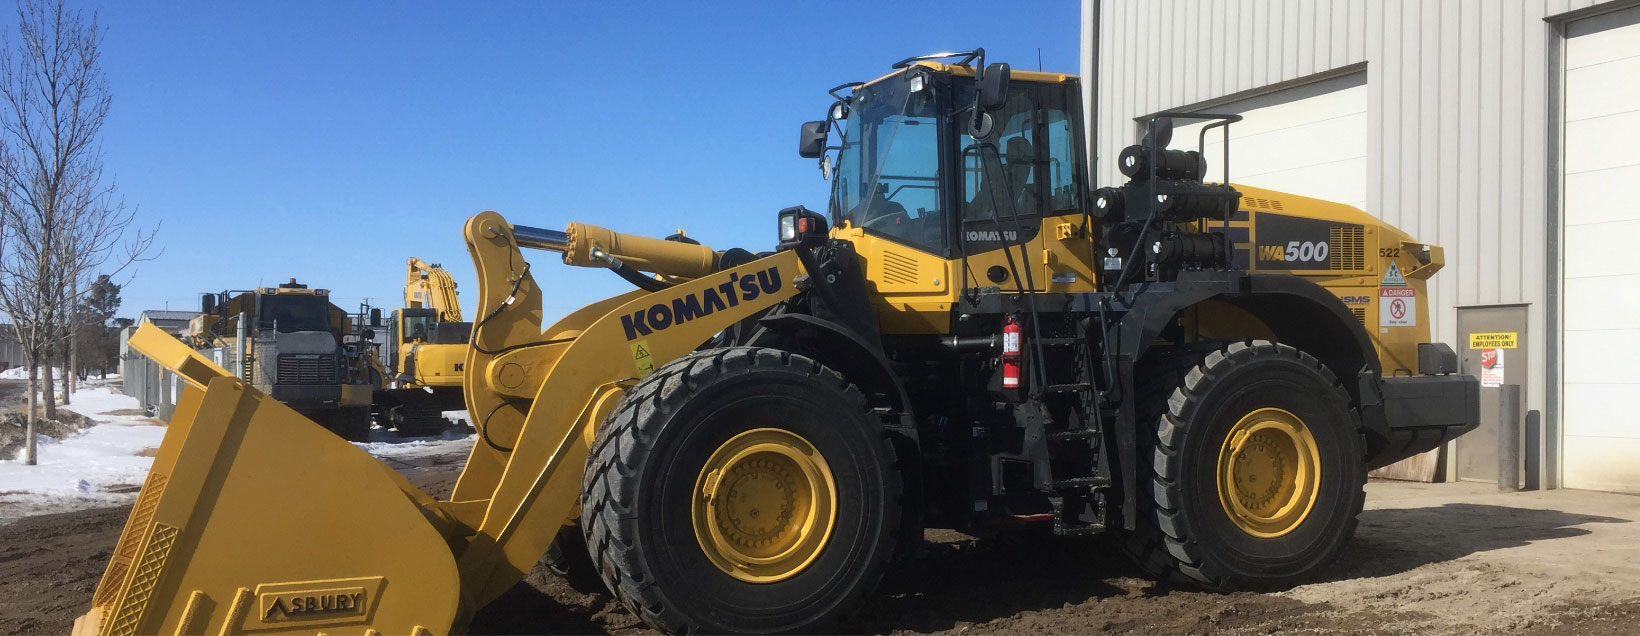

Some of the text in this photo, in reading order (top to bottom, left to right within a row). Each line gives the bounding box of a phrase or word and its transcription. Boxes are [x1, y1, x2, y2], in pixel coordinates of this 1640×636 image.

[961, 231, 1017, 242] OMATSU
[1259, 241, 1329, 262] WA500
[1379, 247, 1400, 258] 522
[620, 266, 782, 341] KOMATSU
[1482, 351, 1496, 362] STOP
[265, 593, 361, 618] ASBURY
